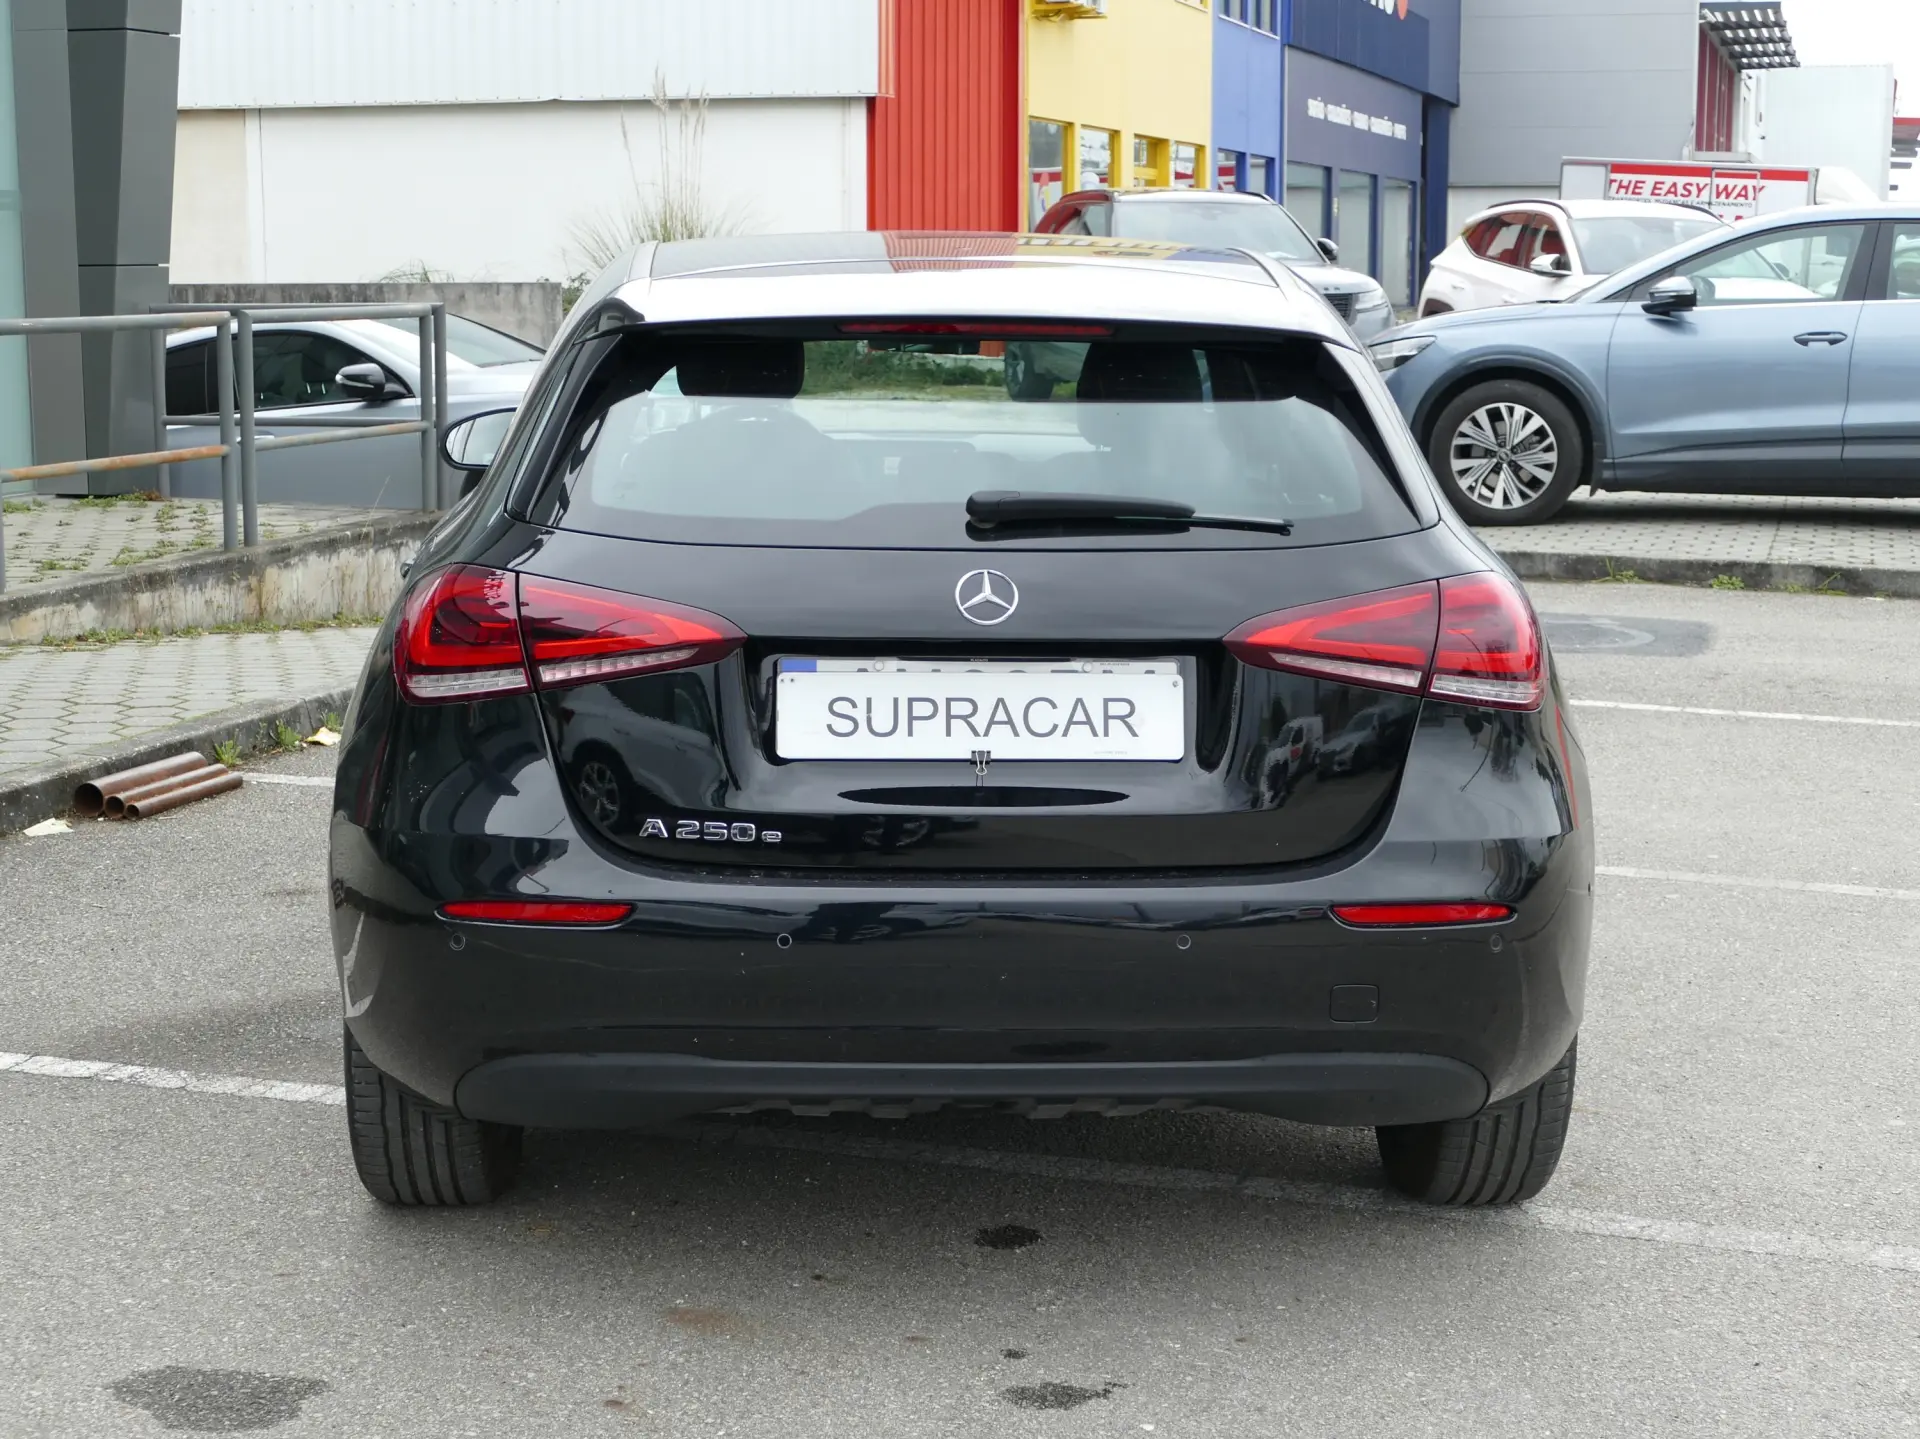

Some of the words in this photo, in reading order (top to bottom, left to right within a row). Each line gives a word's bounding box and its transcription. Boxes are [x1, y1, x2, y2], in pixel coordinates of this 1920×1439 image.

[1609, 178, 1646, 195] THE
[1650, 180, 1709, 199] EASY
[1715, 183, 1766, 201] WAY
[826, 696, 1140, 738] SUPRACAR
[639, 818, 669, 838] A
